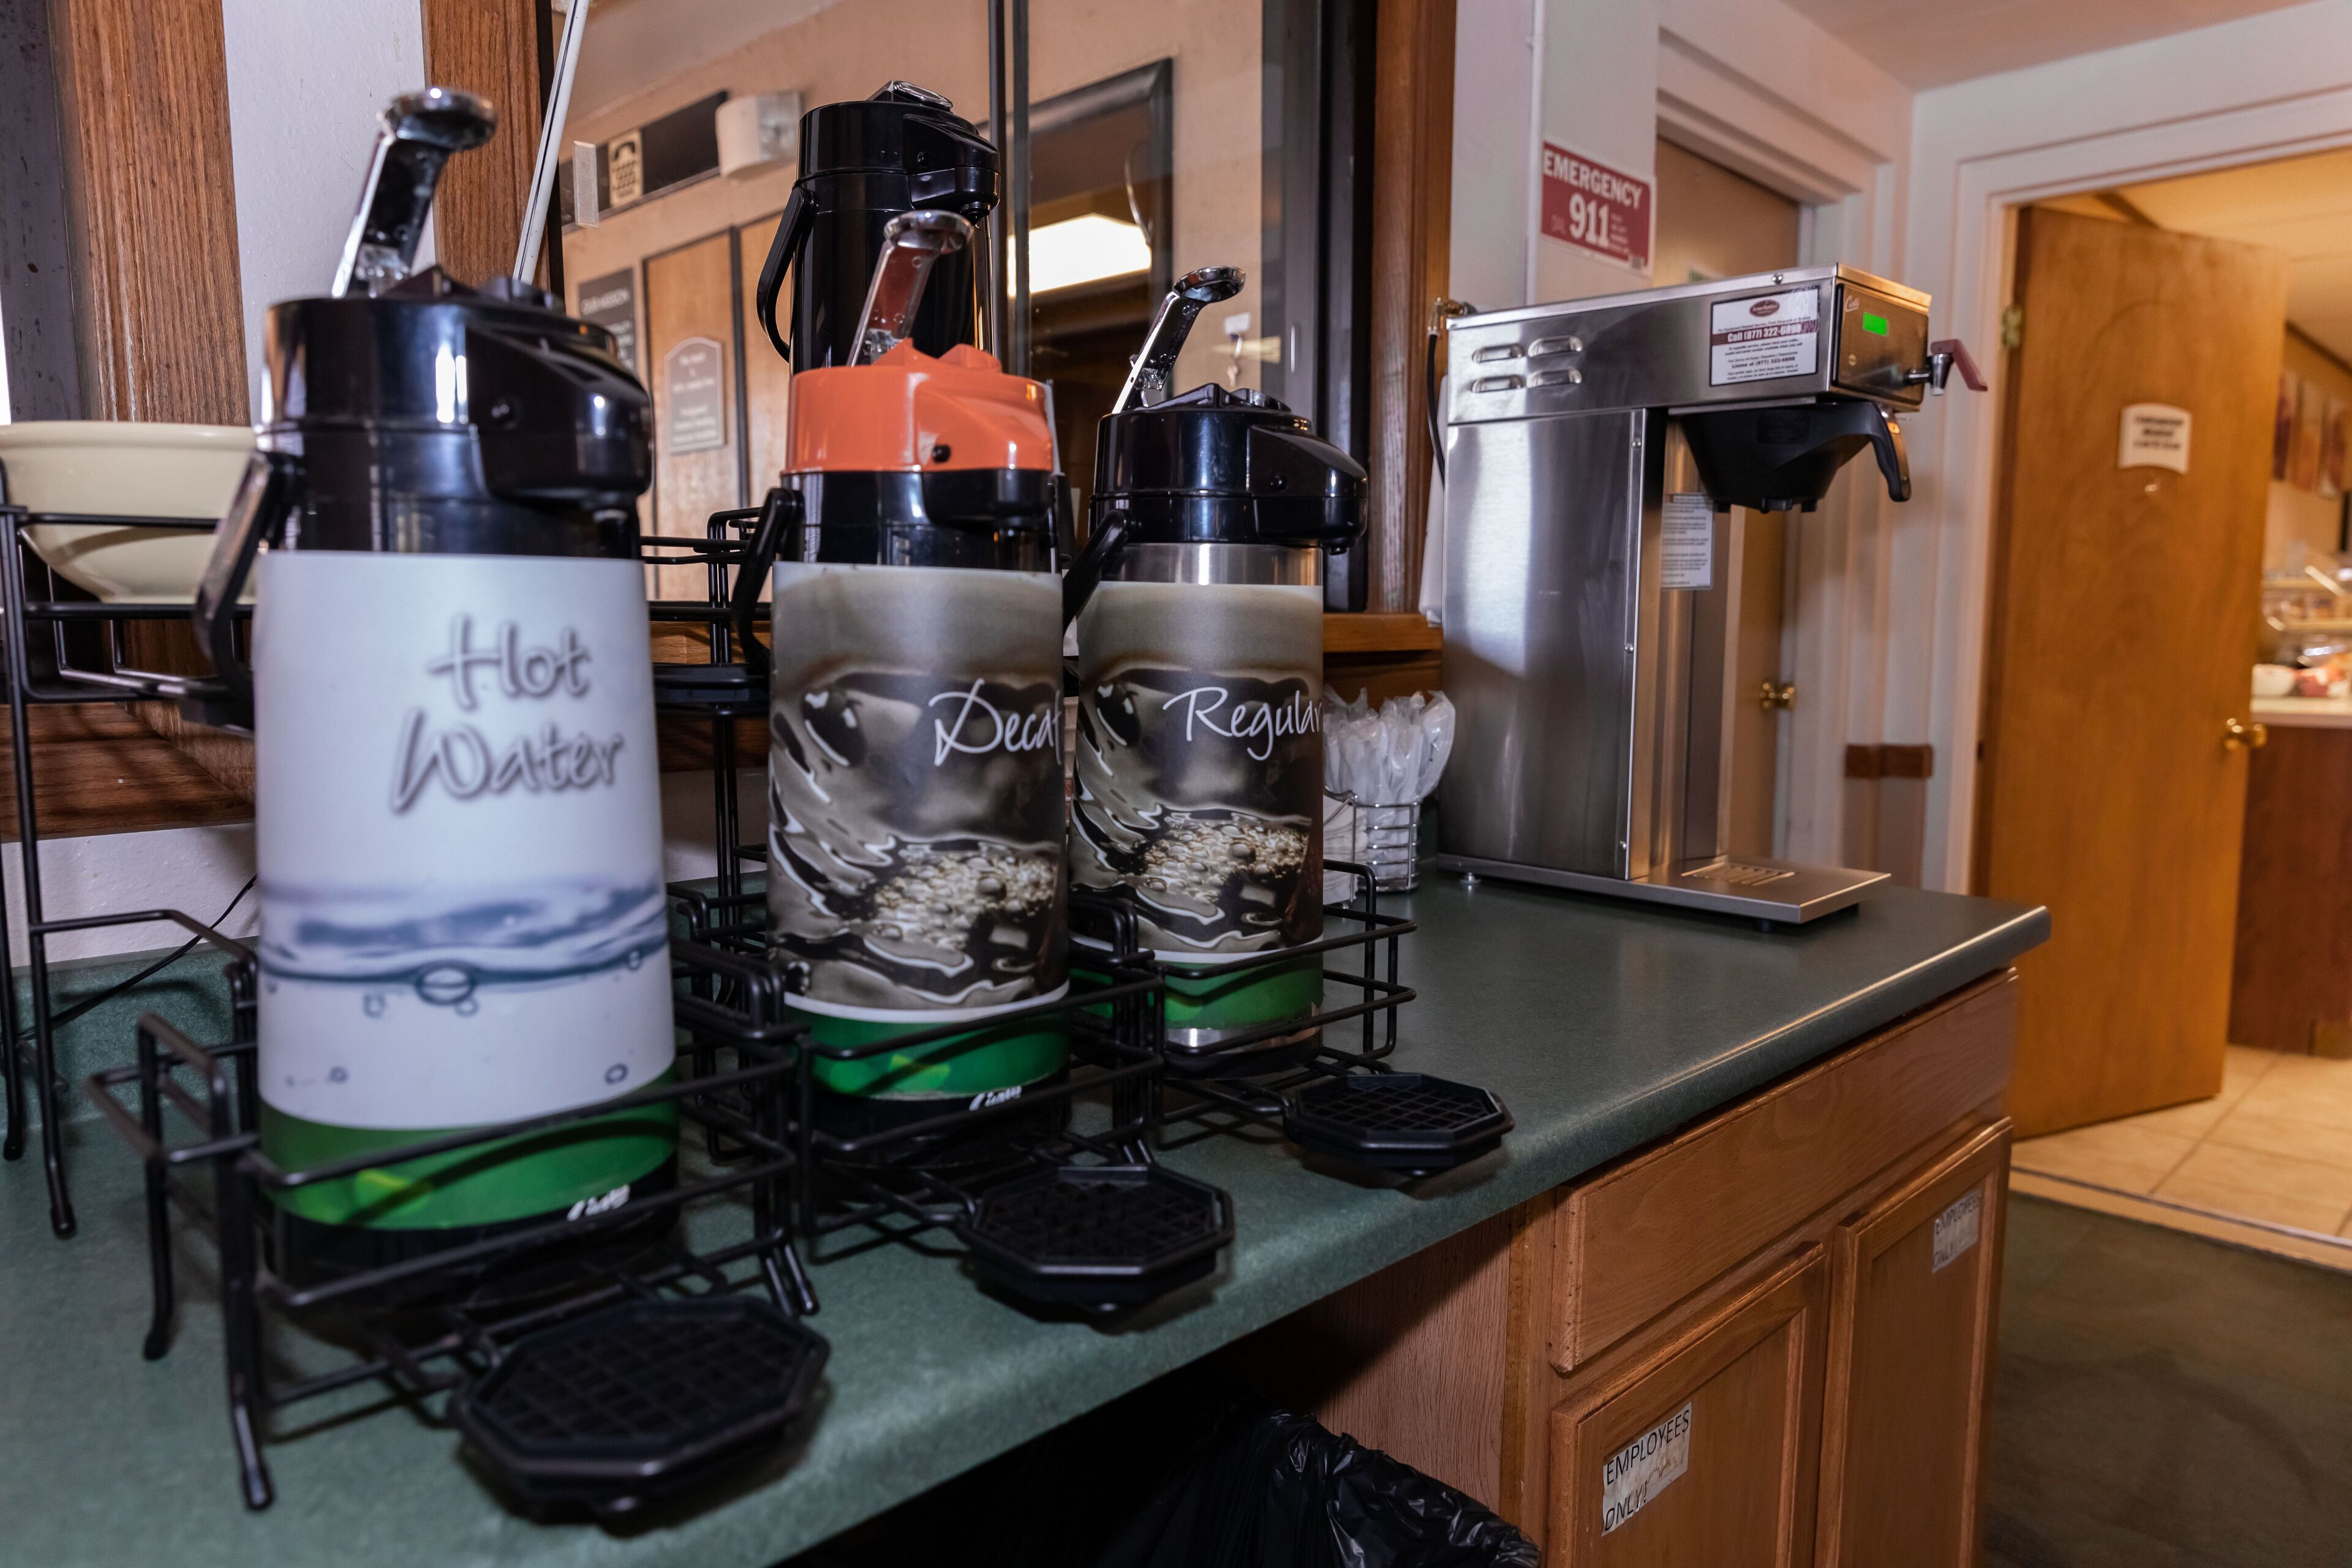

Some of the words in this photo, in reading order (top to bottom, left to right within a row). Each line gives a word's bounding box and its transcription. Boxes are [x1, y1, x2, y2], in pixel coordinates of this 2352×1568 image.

[1544, 150, 1643, 209] EMERGENCY
[1569, 192, 1610, 249] 911
[1727, 331, 1743, 343] Call
[1744, 329, 1763, 341] (877)
[1763, 323, 1801, 337] 322-6898
[428, 614, 593, 712] Hot
[929, 677, 1062, 766] Decaf
[1163, 686, 1322, 761] Regular
[390, 708, 625, 817] Water
[1607, 1410, 1689, 1485] EMPLOYEES
[1605, 1480, 1648, 1532] ONLY!
